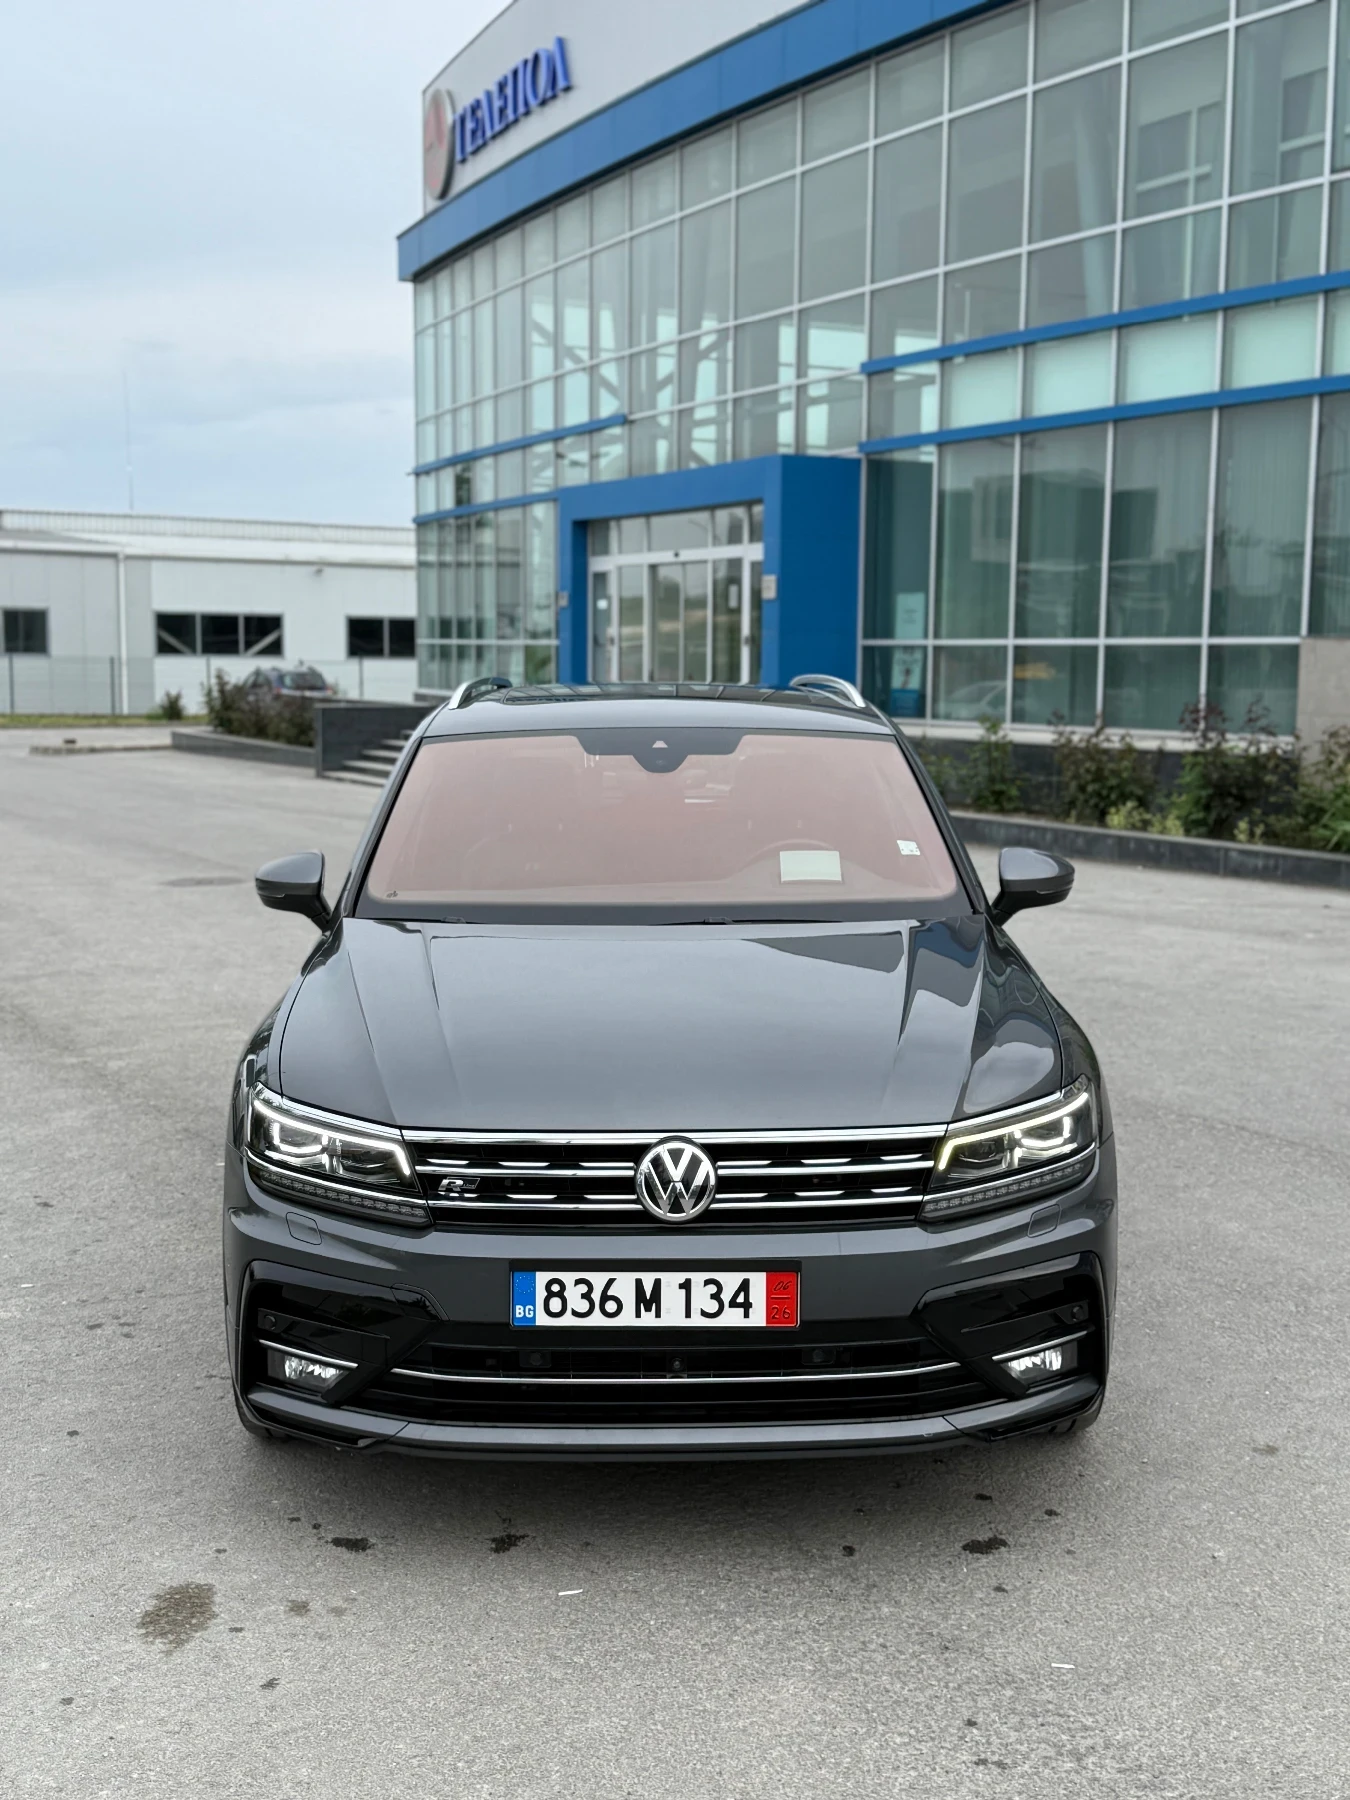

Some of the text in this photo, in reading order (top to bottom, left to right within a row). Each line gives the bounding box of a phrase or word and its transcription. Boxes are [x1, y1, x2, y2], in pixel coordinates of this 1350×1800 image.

[773, 1280, 793, 1291] 06
[543, 1277, 753, 1319] 836 M 134
[515, 1304, 534, 1318] BG
[771, 1304, 791, 1320] 26
